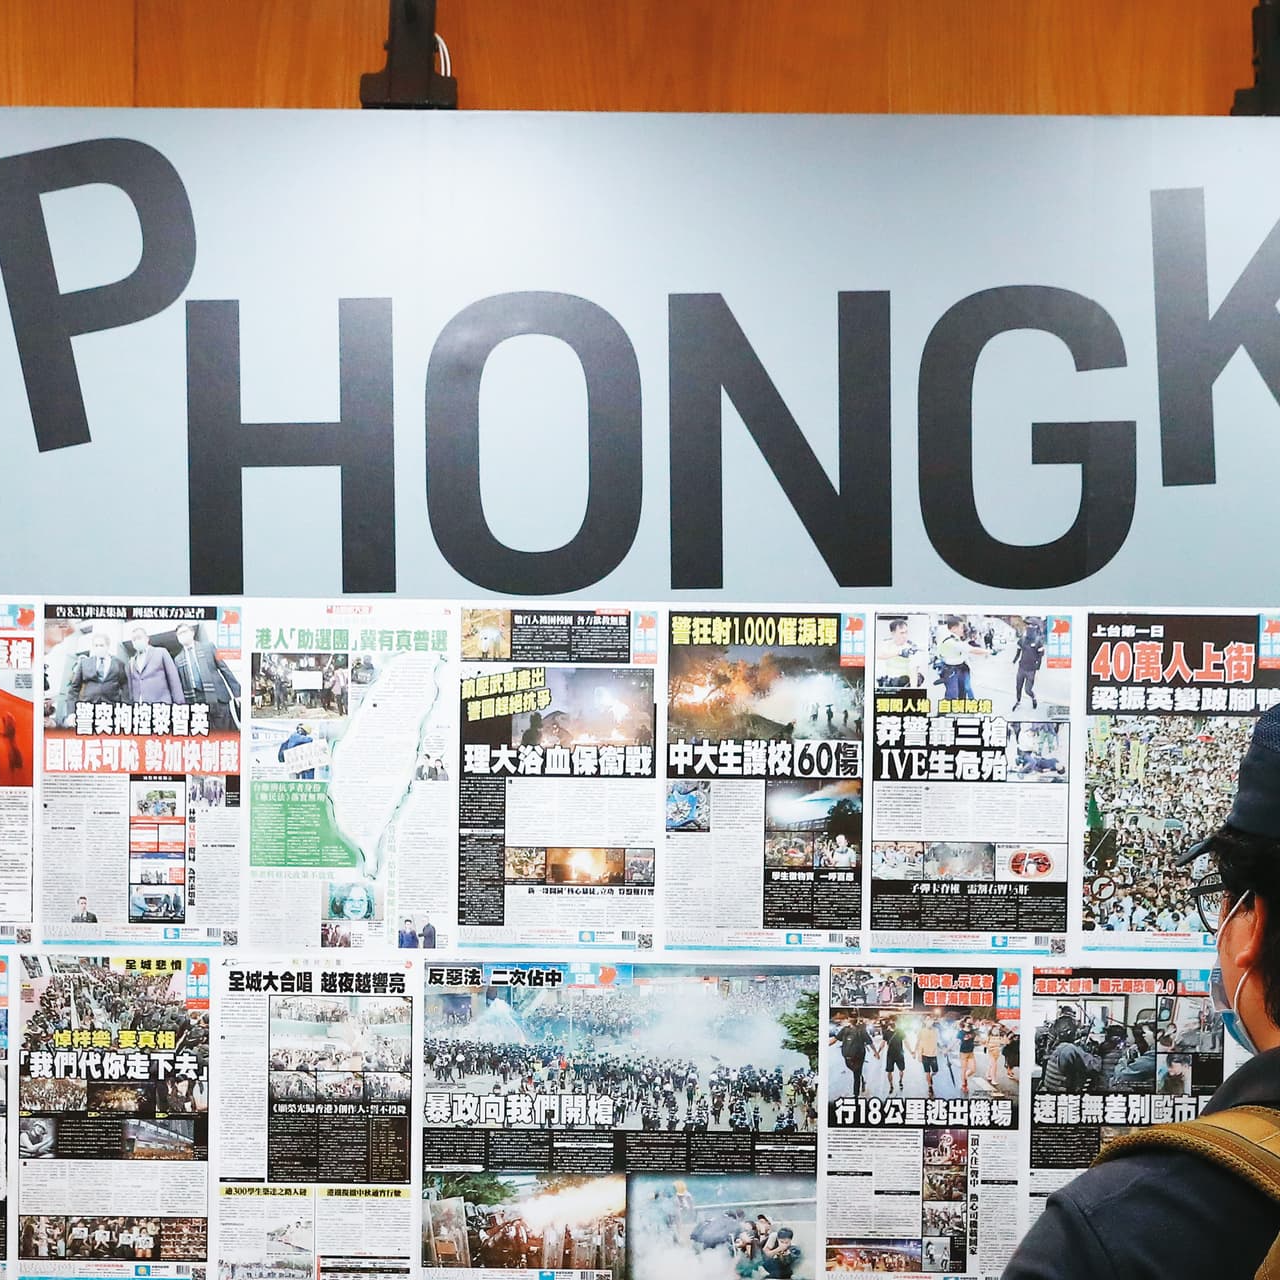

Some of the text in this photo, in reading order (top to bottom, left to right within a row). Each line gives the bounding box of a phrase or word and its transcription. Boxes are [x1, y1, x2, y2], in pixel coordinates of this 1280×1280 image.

[185, 283, 1139, 597] HONG
[1092, 640, 1255, 684] 40萬人上街
[491, 968, 562, 986] 二次佔中
[19, 1048, 209, 1080] 「我們代你走下去」
[424, 1092, 615, 1126] 暴政向我們開槍
[834, 1096, 1013, 1128] 行18公里逃出機場
